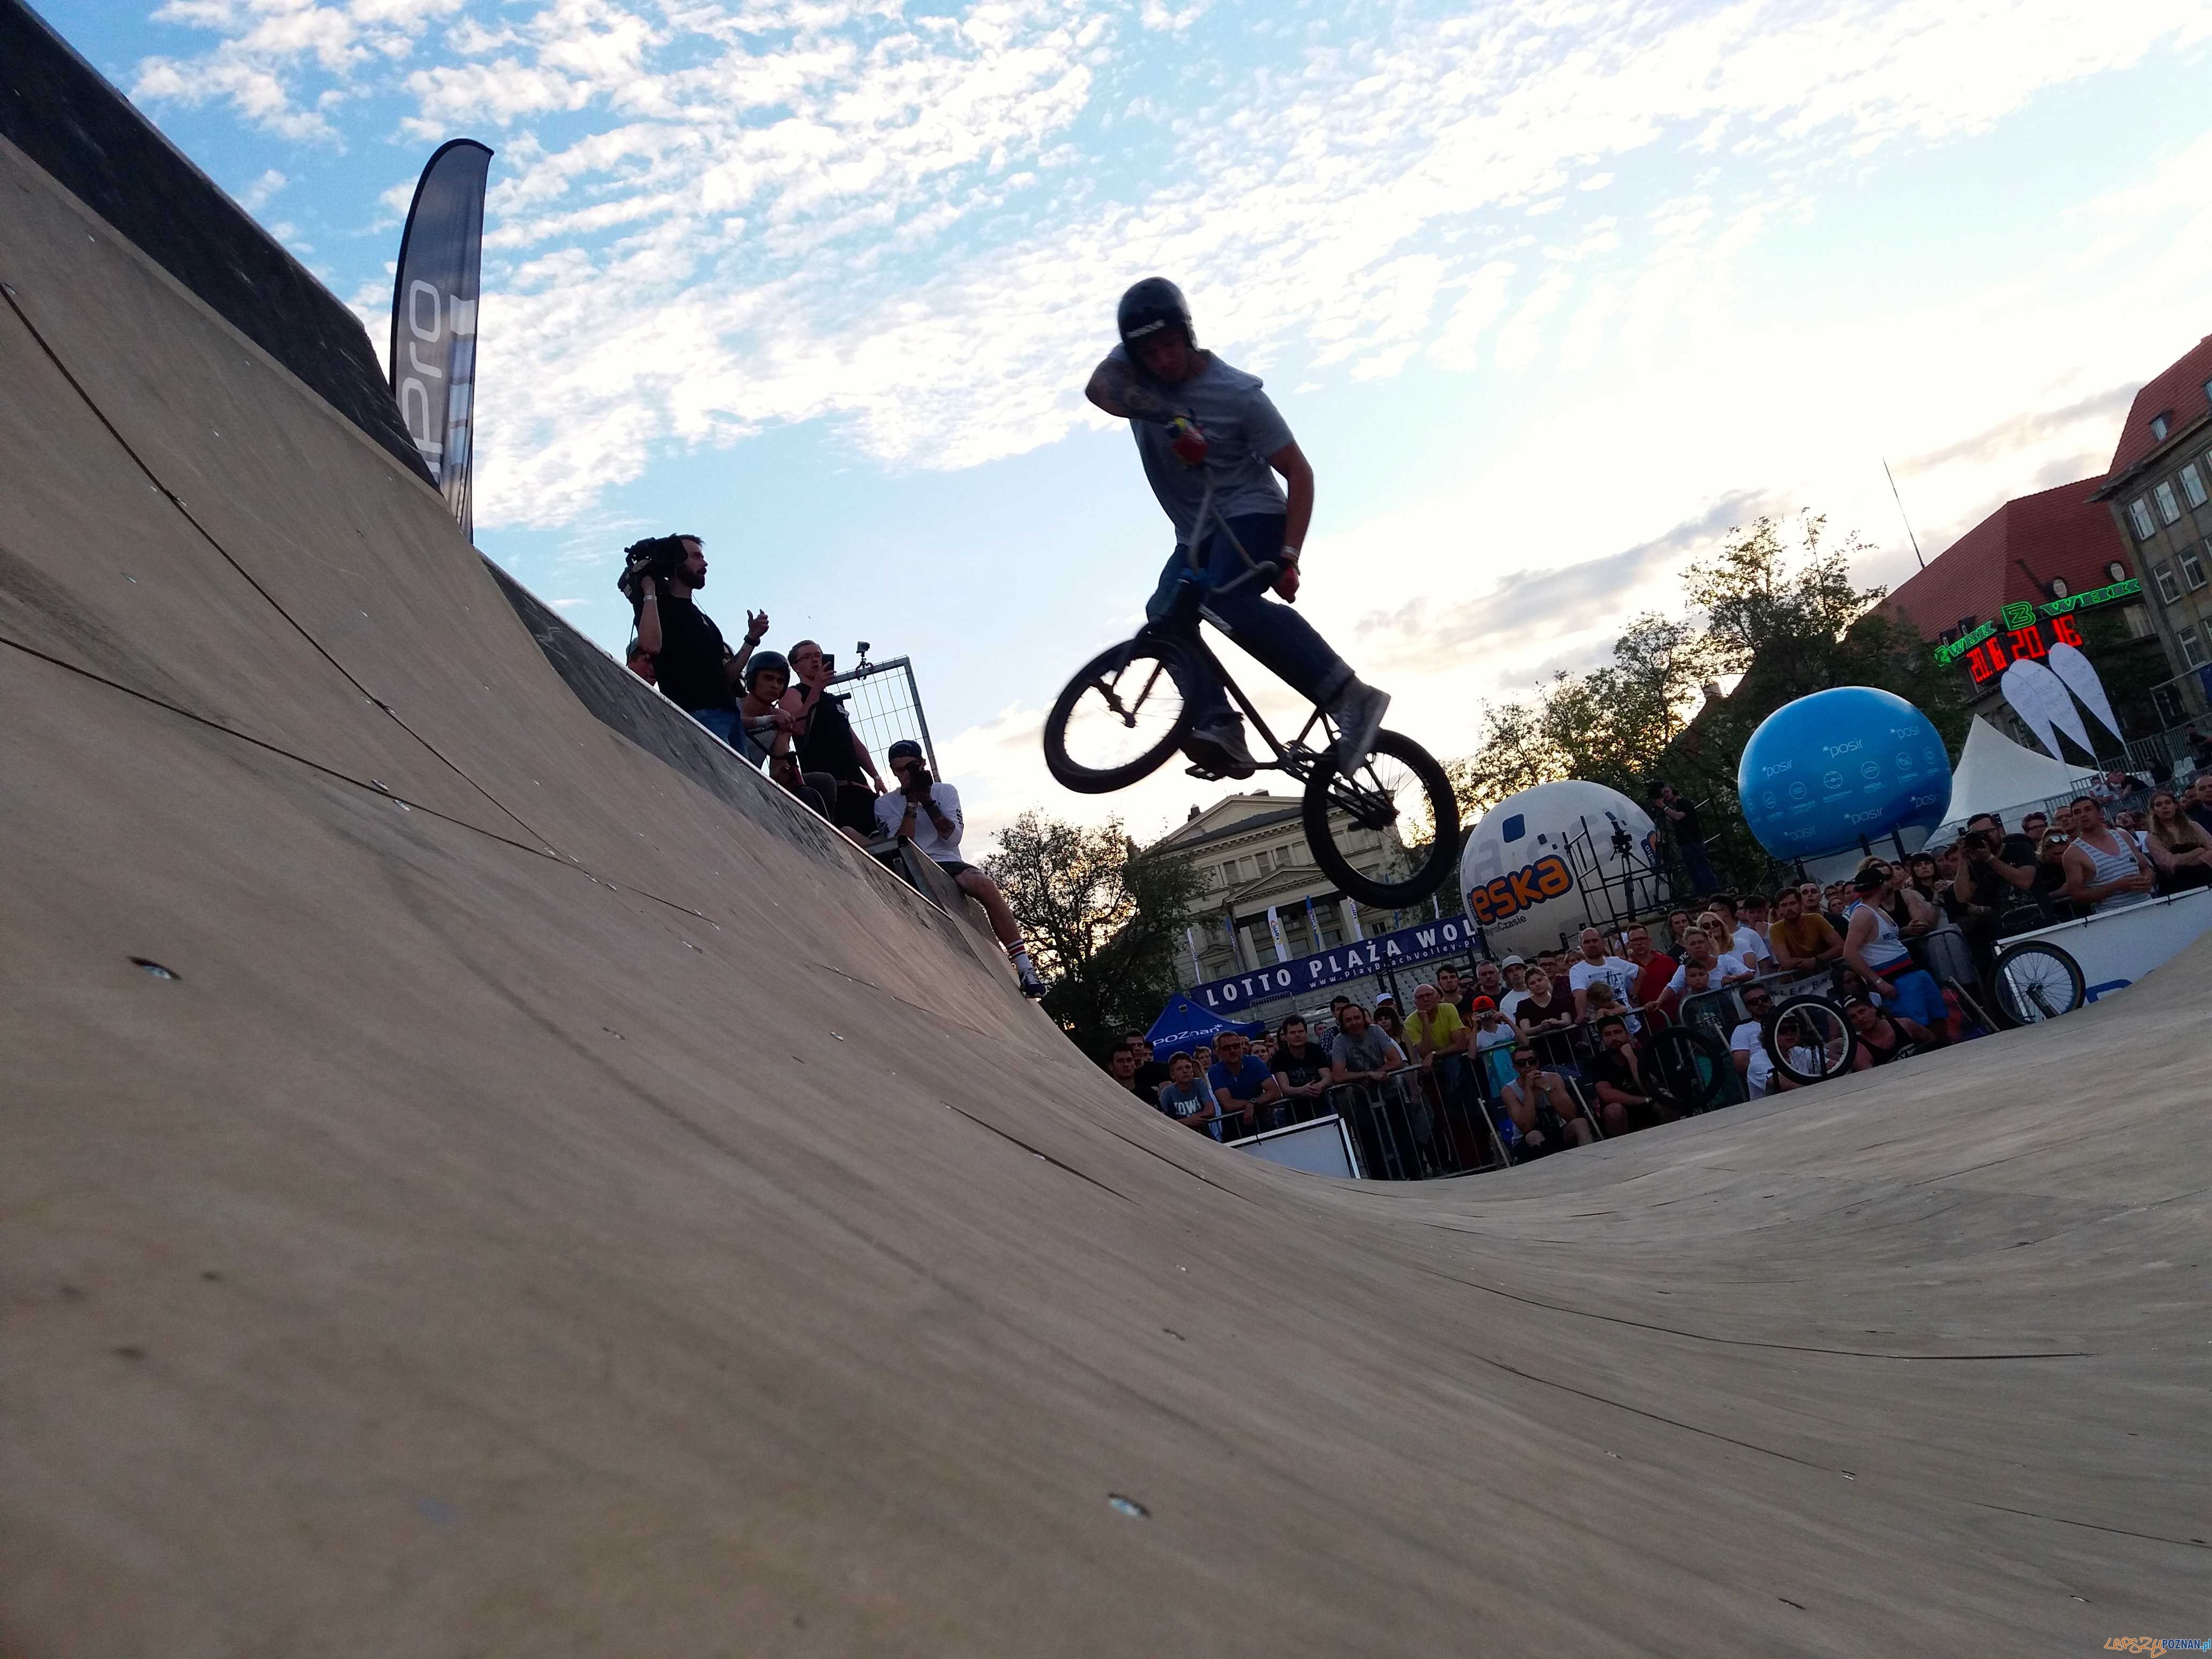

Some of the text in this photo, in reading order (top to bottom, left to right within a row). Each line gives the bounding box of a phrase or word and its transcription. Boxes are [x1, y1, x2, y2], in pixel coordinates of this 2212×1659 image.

[1206, 919, 1476, 1006] LOTTO PLAŻA WOL
